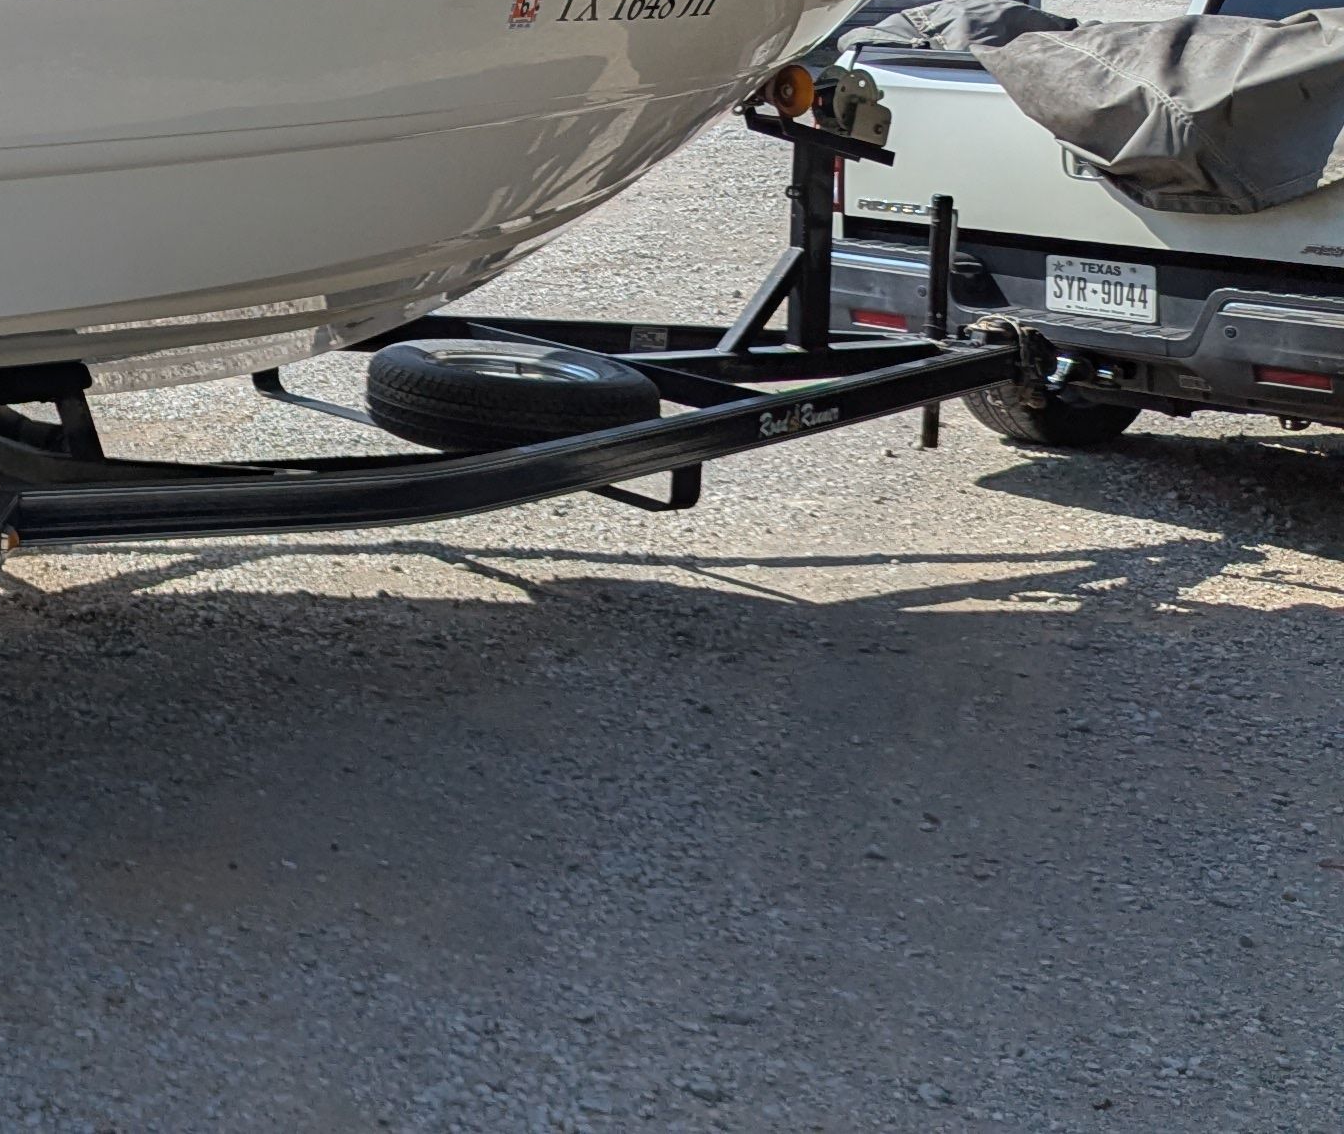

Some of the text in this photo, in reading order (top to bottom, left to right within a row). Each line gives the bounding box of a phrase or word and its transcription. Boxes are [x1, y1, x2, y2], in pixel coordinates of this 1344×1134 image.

[1080, 262, 1121, 276] TEXAS
[1053, 274, 1148, 310] SYR 9044
